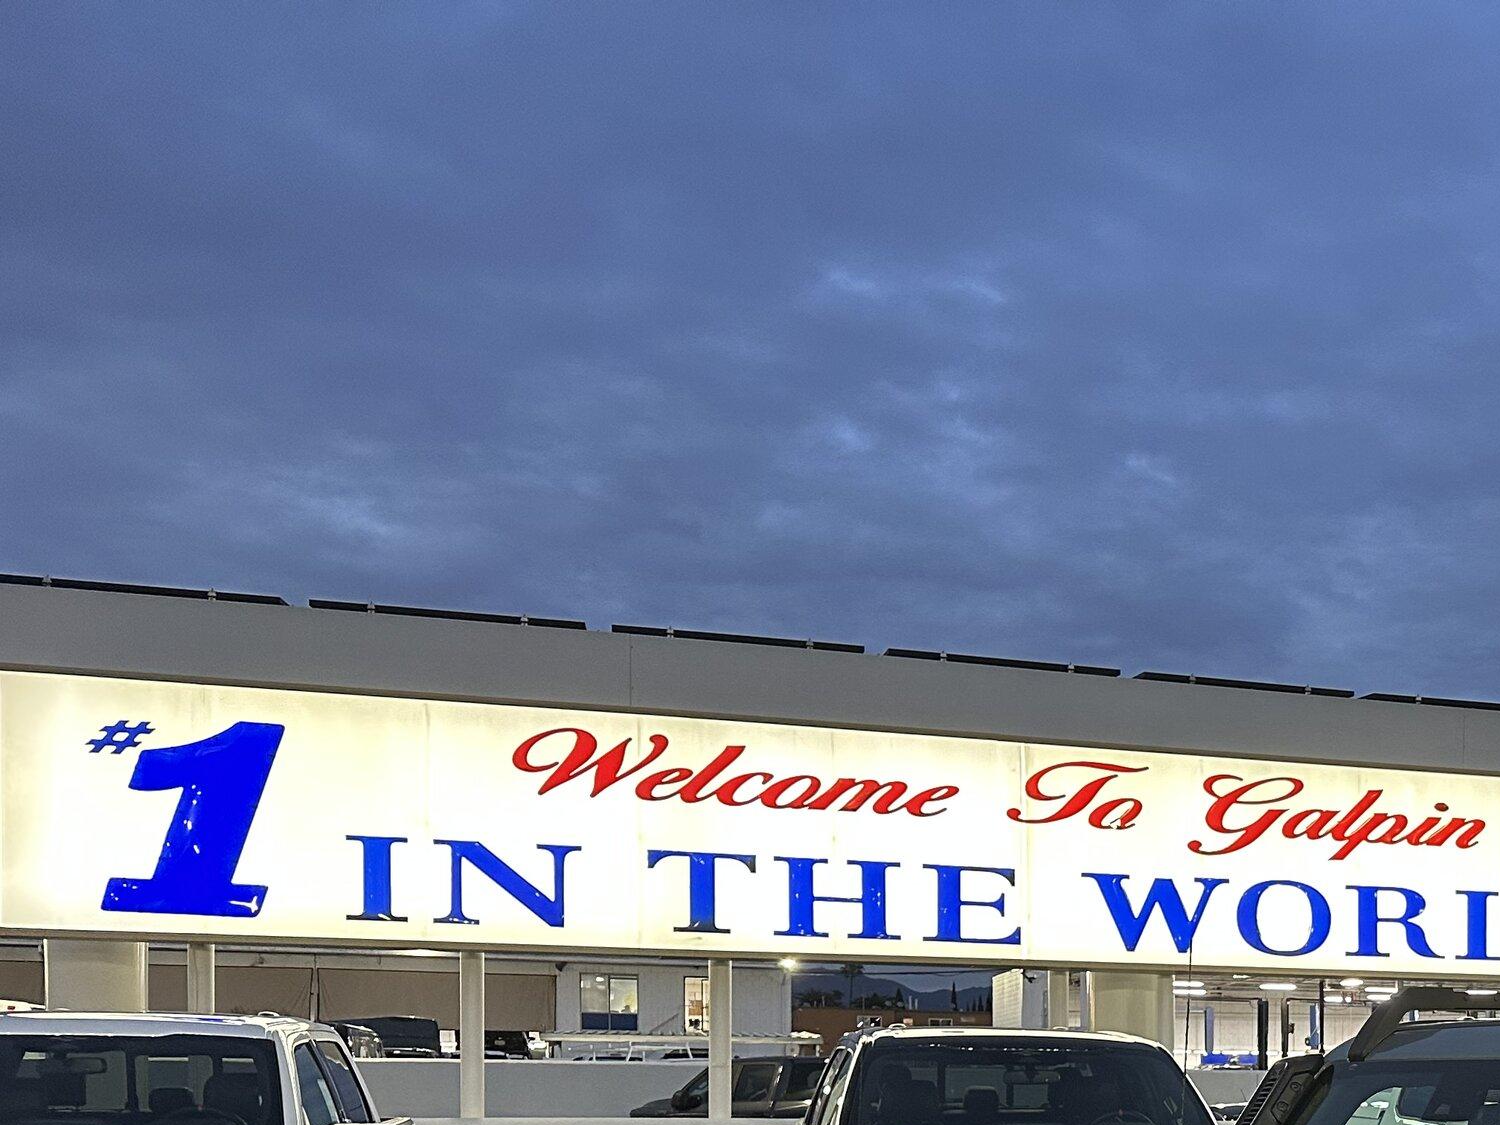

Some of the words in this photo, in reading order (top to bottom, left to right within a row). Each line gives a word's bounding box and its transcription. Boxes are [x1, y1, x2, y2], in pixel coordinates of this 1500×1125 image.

[512, 727, 960, 817] Welcome
[1007, 761, 1150, 830] To
[1187, 774, 1487, 862] Galpin
[345, 834, 583, 928] IN
[647, 849, 1022, 946] THE
